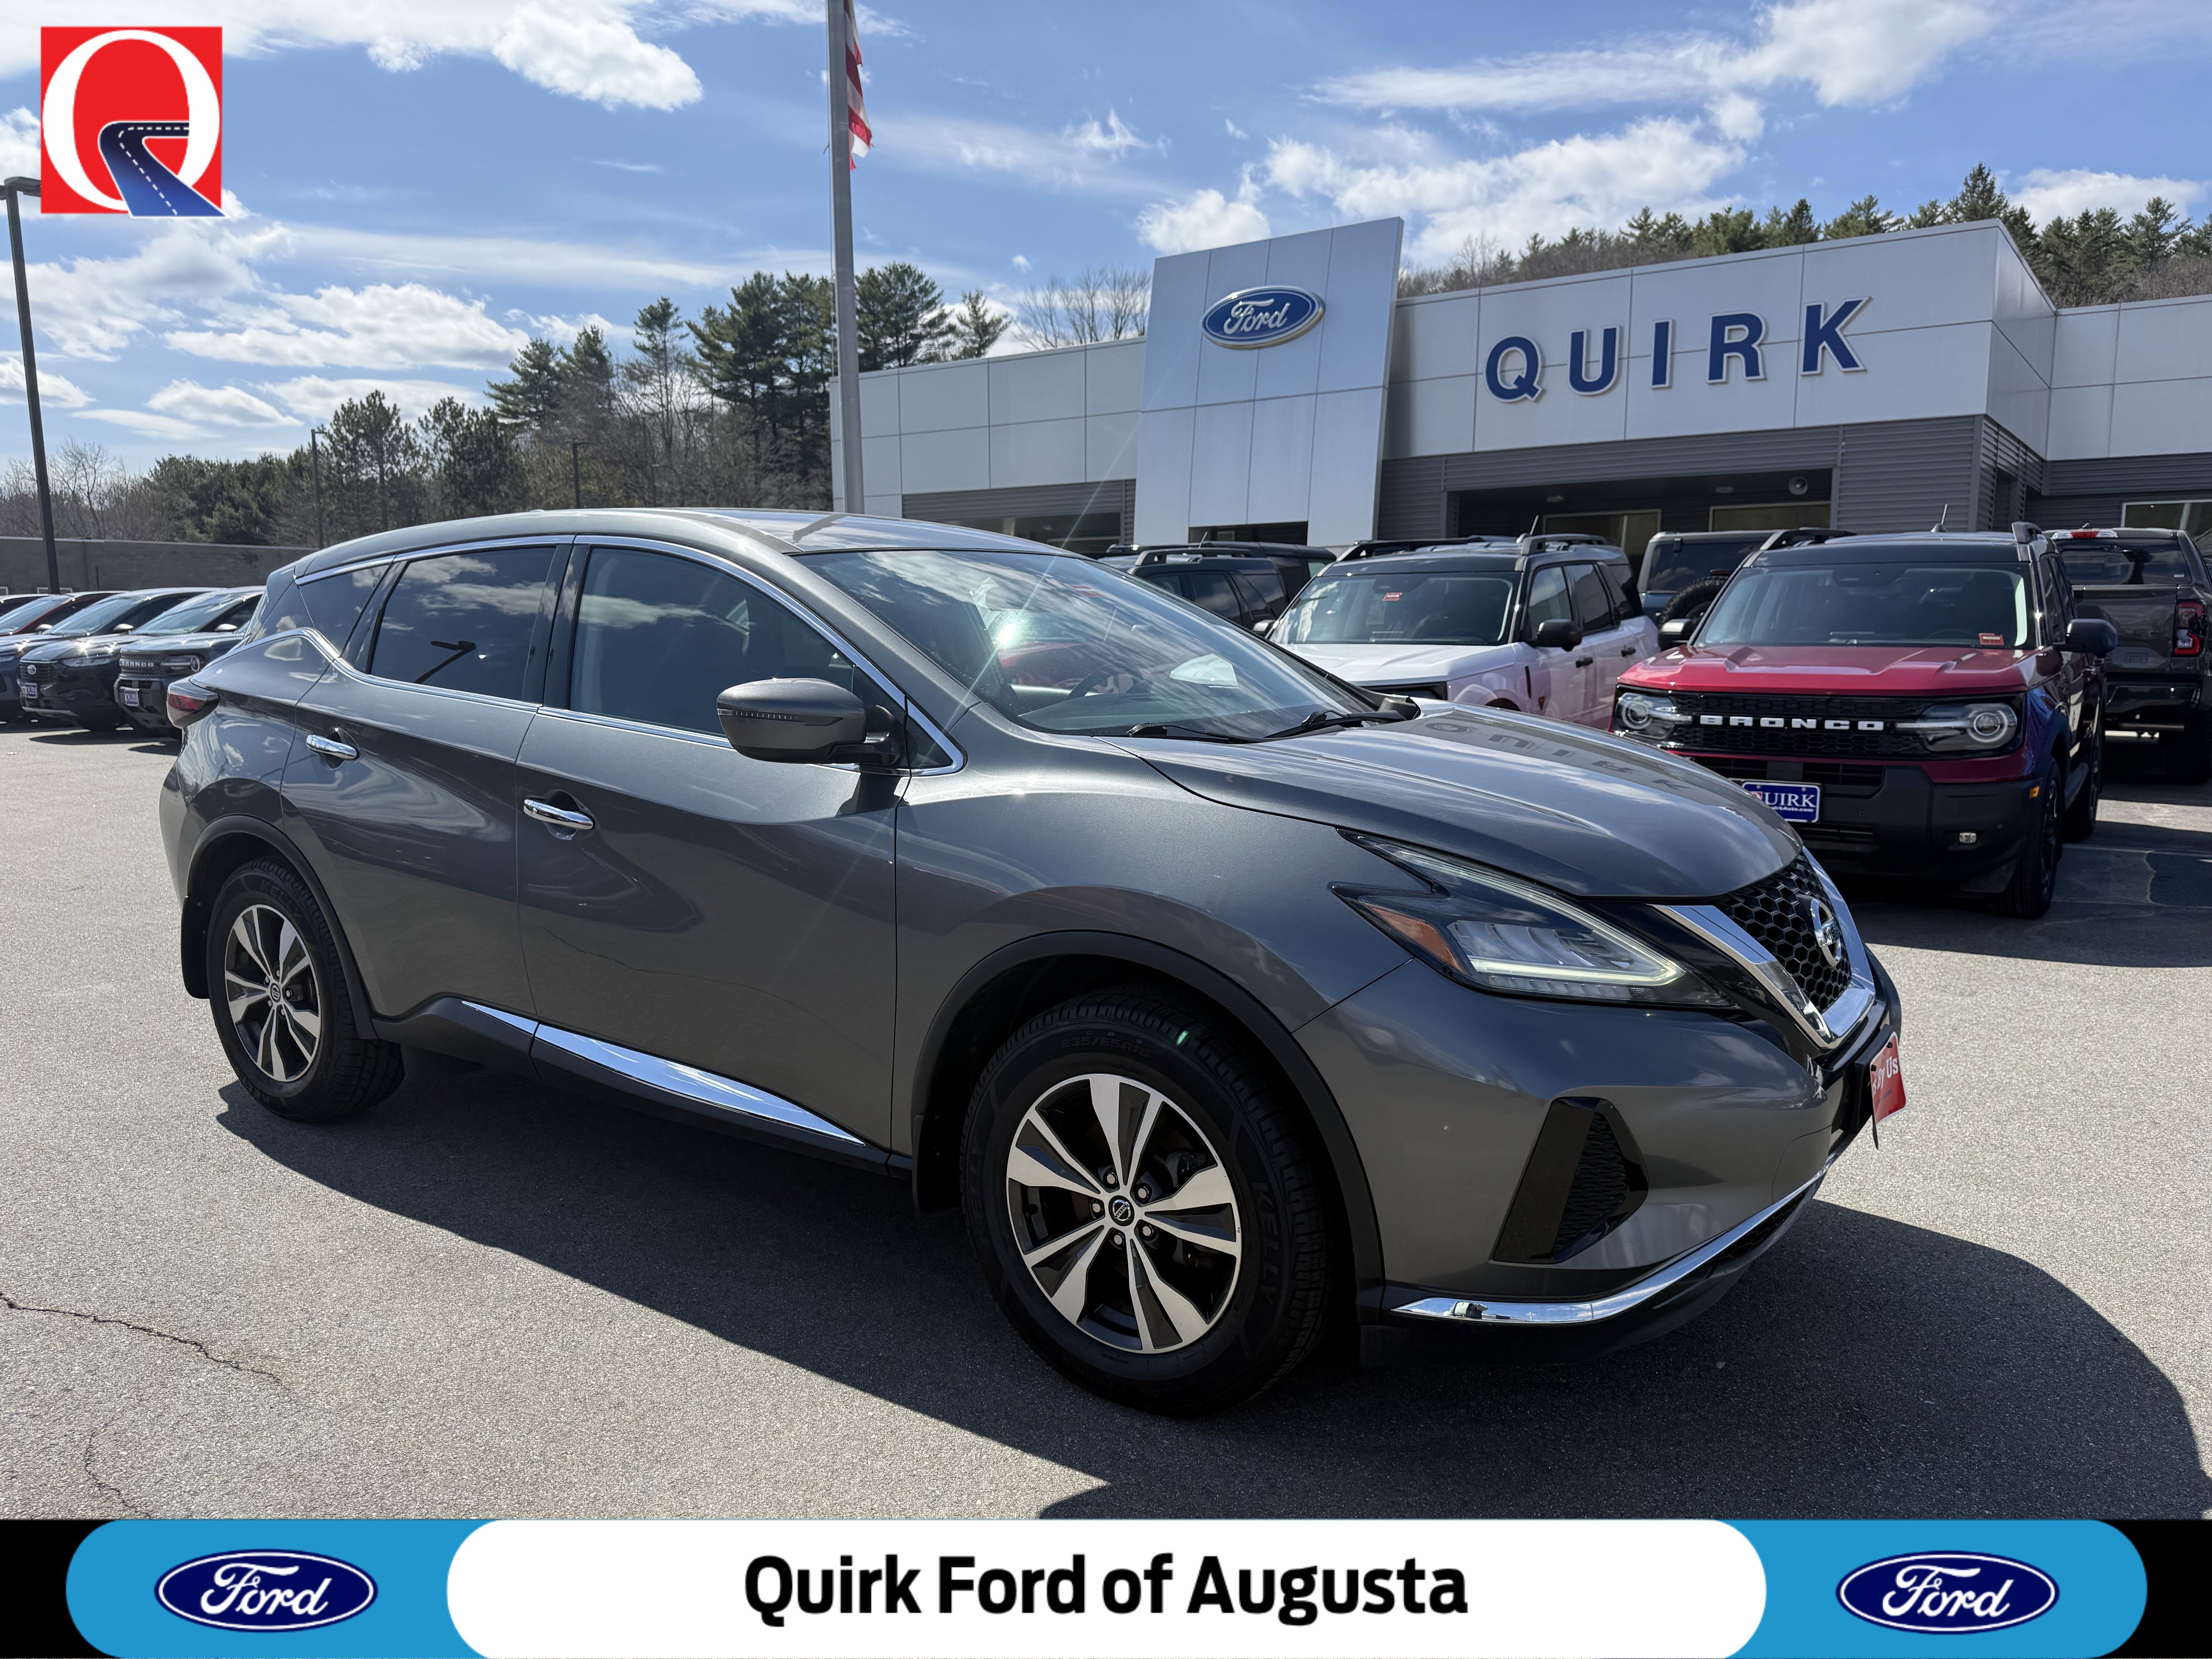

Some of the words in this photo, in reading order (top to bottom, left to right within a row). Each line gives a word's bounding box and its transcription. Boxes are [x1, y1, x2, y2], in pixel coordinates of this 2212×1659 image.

[1223, 297, 1291, 335] Ford
[1484, 295, 1874, 403] QUIRK
[1700, 715, 1884, 731] BRONCO
[1750, 791, 1816, 807] UIRK
